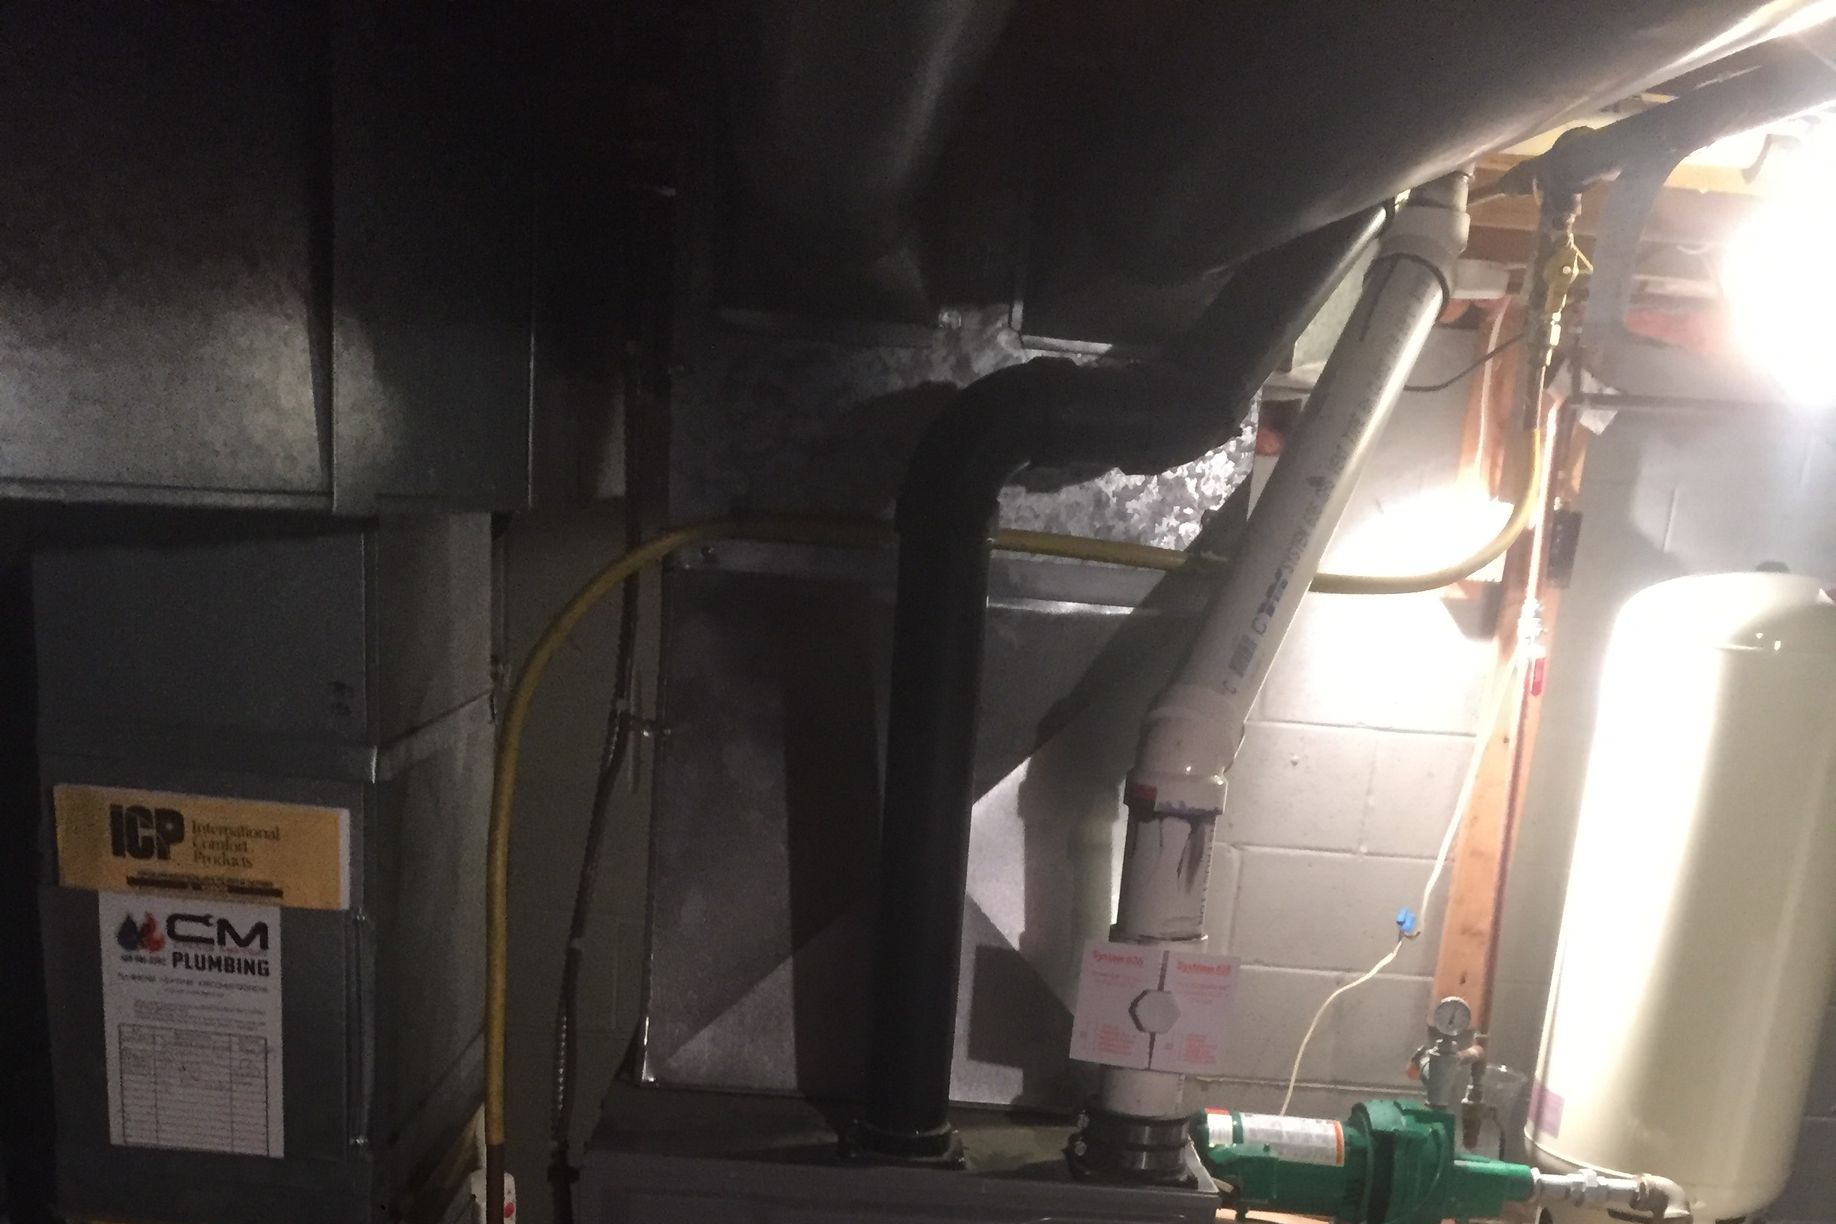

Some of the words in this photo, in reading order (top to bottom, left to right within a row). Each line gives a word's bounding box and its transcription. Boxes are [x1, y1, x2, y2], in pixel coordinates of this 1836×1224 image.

[191, 820, 279, 841] International
[192, 838, 248, 854] Comfort
[193, 850, 253, 869] Products
[167, 913, 269, 950] CM
[172, 952, 270, 977] PLUMBING
